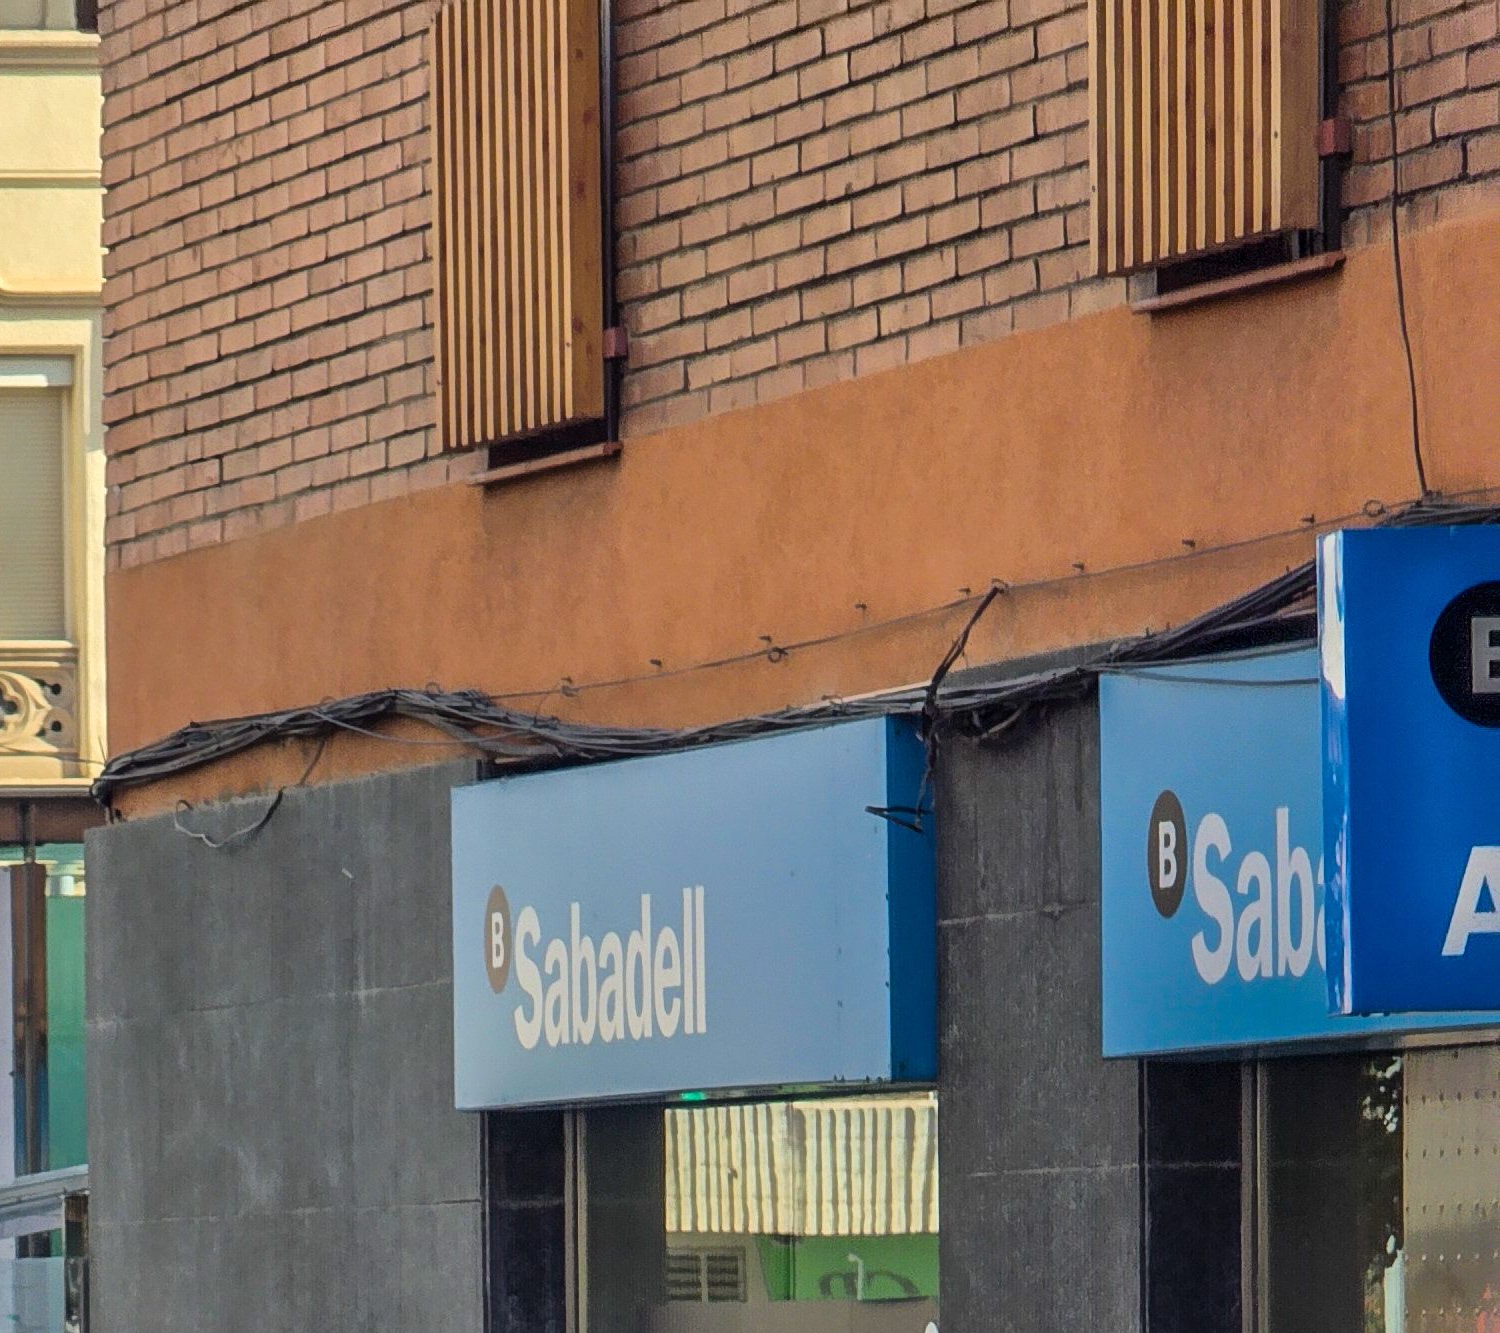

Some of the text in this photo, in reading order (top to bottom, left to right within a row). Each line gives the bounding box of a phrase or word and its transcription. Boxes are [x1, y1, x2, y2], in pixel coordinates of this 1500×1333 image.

[491, 884, 707, 1050] B Sabadell
[1158, 806, 1326, 985] B Sab
